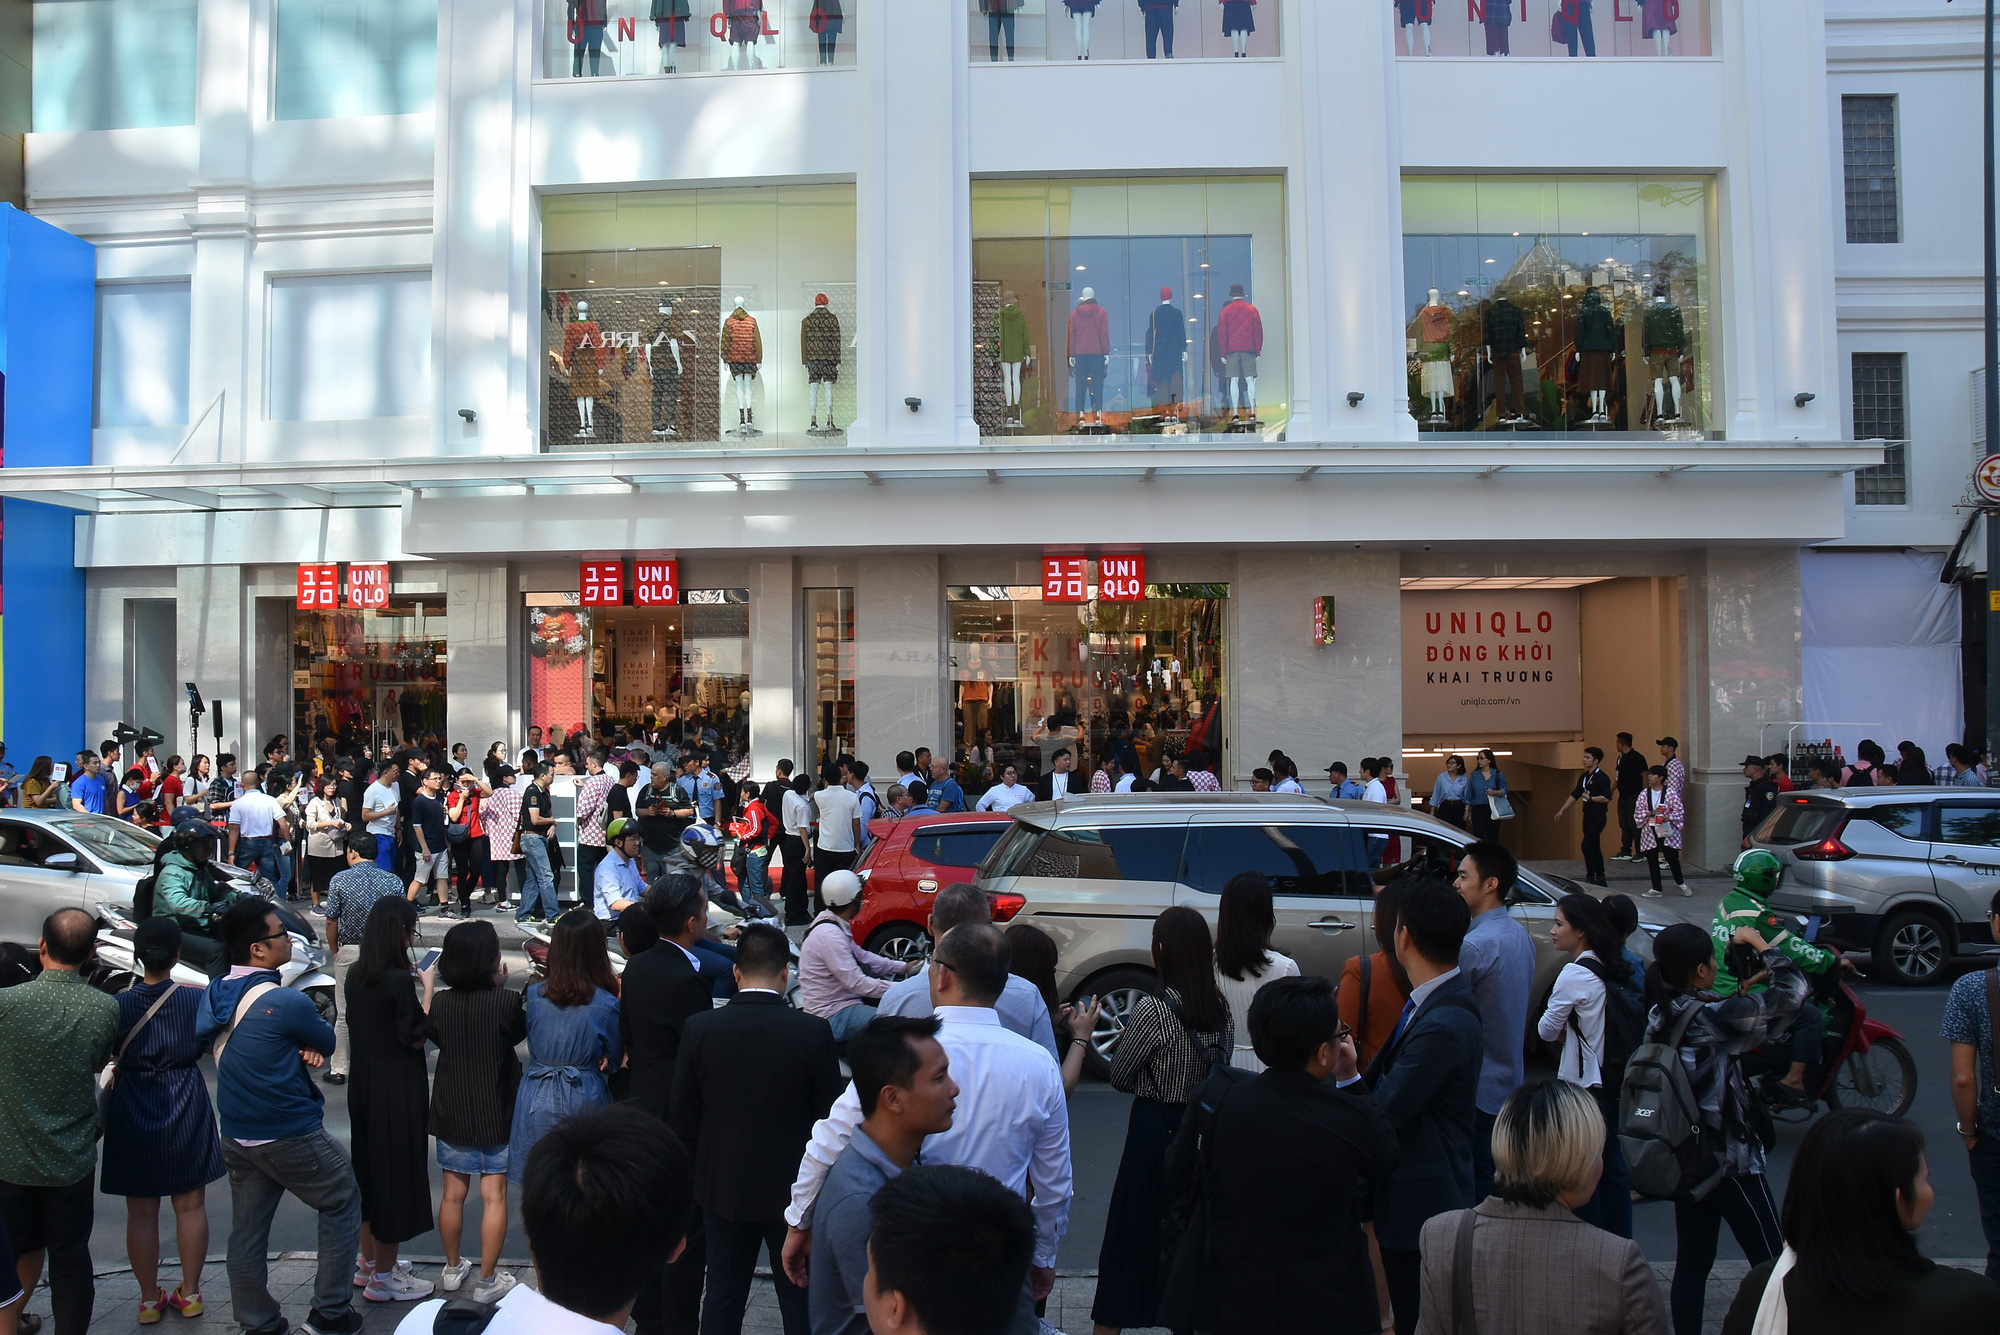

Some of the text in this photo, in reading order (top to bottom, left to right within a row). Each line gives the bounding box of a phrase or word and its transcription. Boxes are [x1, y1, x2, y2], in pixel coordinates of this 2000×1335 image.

[1415, 0, 1680, 26] UNIQLO
[567, 8, 827, 45] UNIQLO
[639, 567, 669, 581] UNI
[1104, 561, 1135, 576] UNI
[352, 570, 381, 585] UNI
[353, 588, 384, 605] QLO
[639, 585, 672, 602] QLO
[1104, 580, 1139, 598] QLO
[1426, 611, 1551, 637] UNIQLO
[1426, 640, 1552, 661] ĐỒNG KHỞI
[1427, 671, 1553, 683] KHAI TRƯƠNG
[1461, 697, 1521, 707] uniqlo.com/vn
[1974, 864, 2000, 876] CIT
[1790, 936, 1825, 964] Grab
[1635, 1108, 1655, 1117] acer
